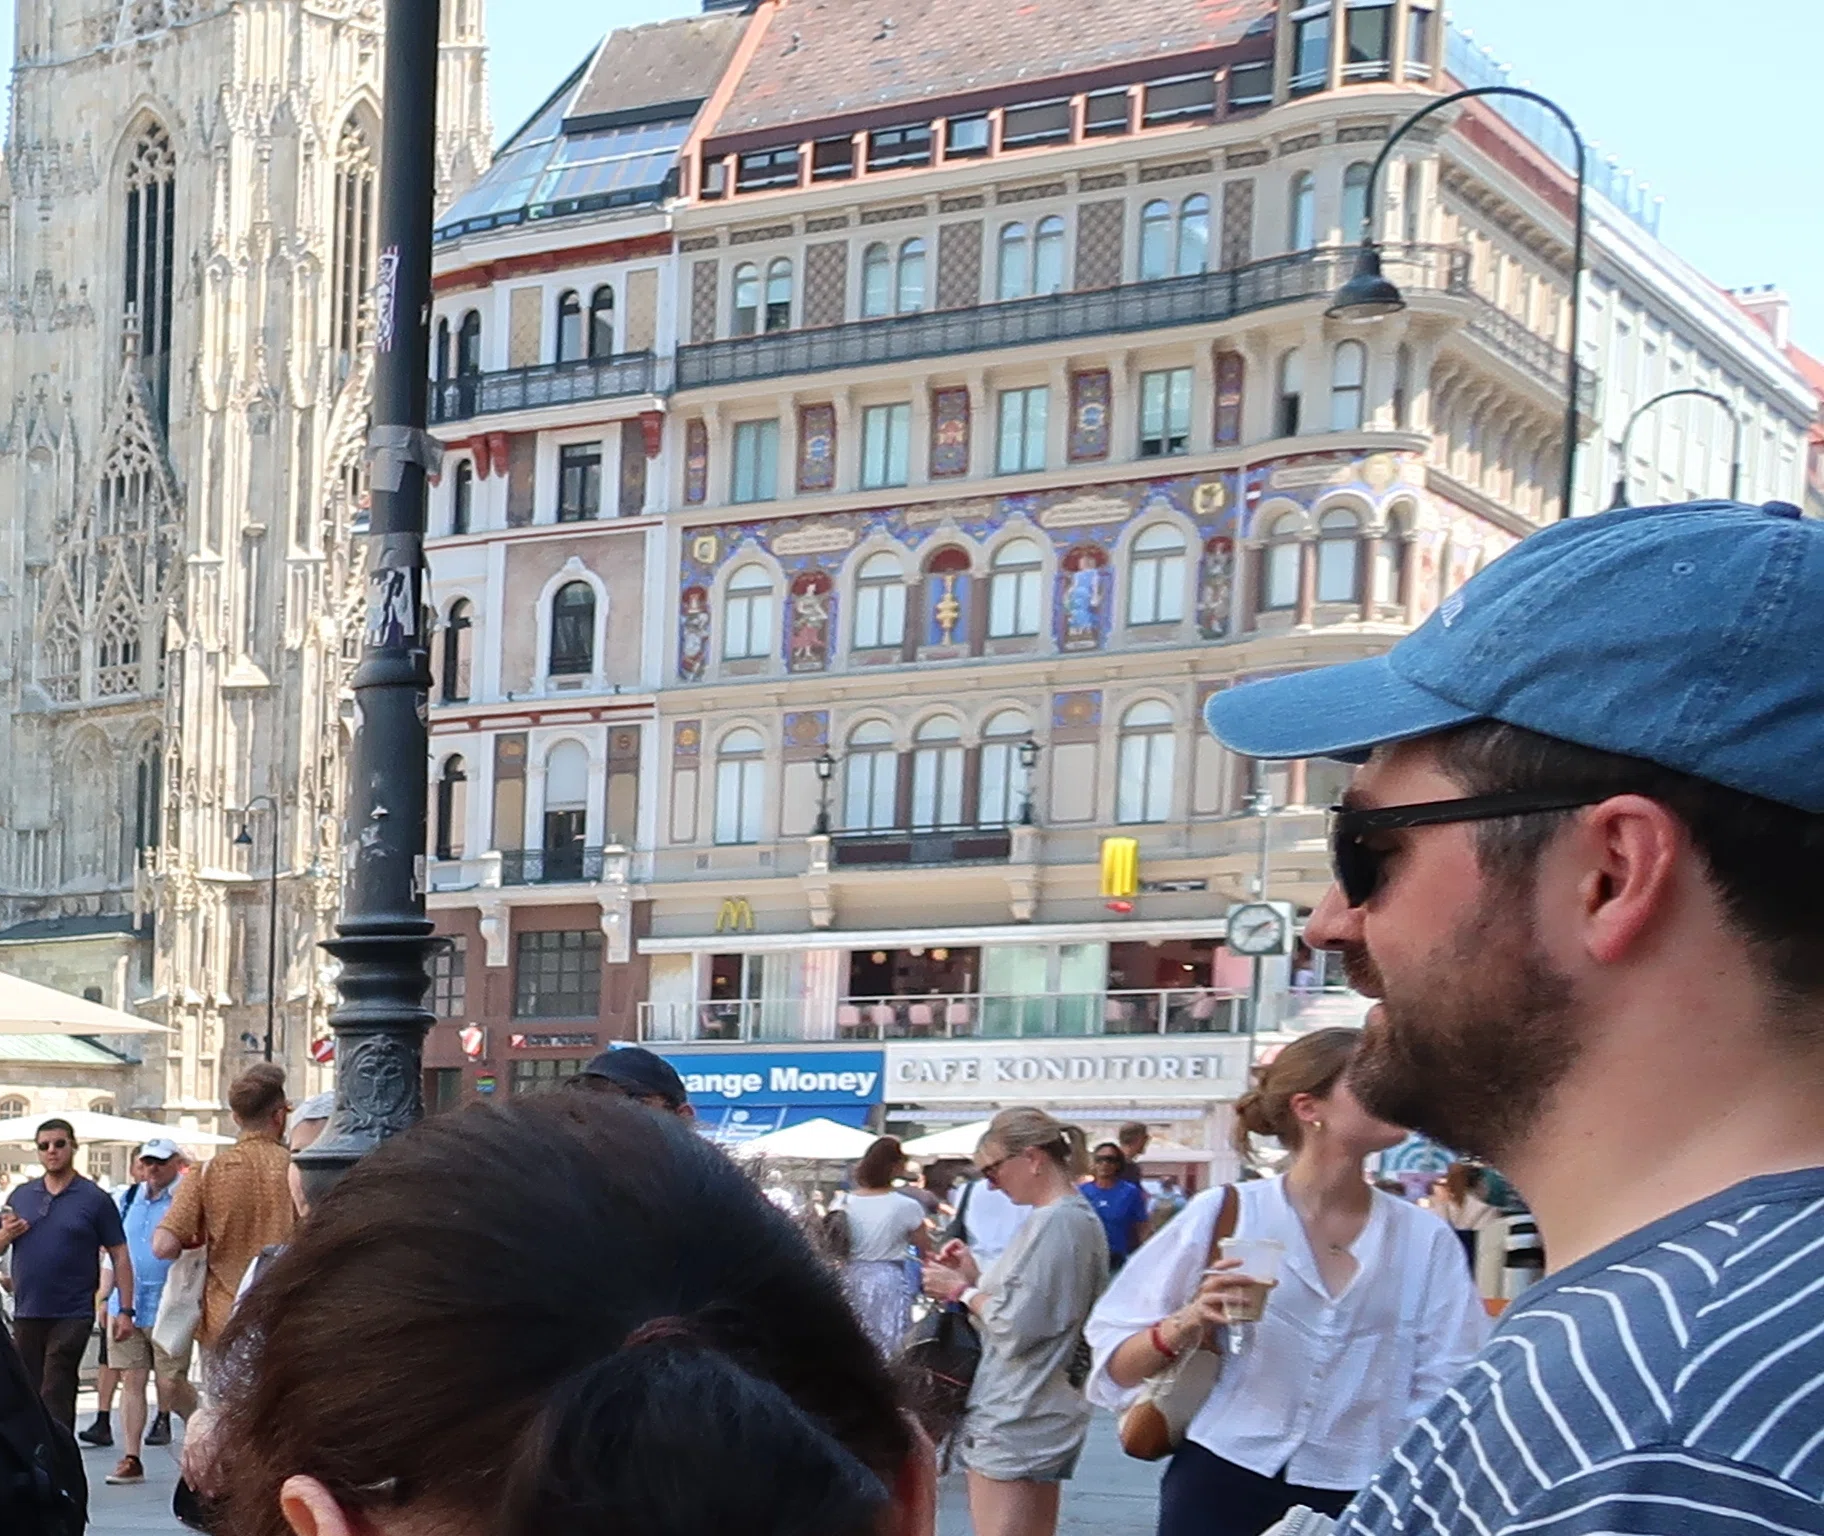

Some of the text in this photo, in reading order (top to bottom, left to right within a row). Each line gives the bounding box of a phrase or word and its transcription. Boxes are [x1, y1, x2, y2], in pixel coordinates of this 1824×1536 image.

[680, 1067, 878, 1099] ange Money
[895, 1053, 1226, 1083] CAFE KONDITOREI
